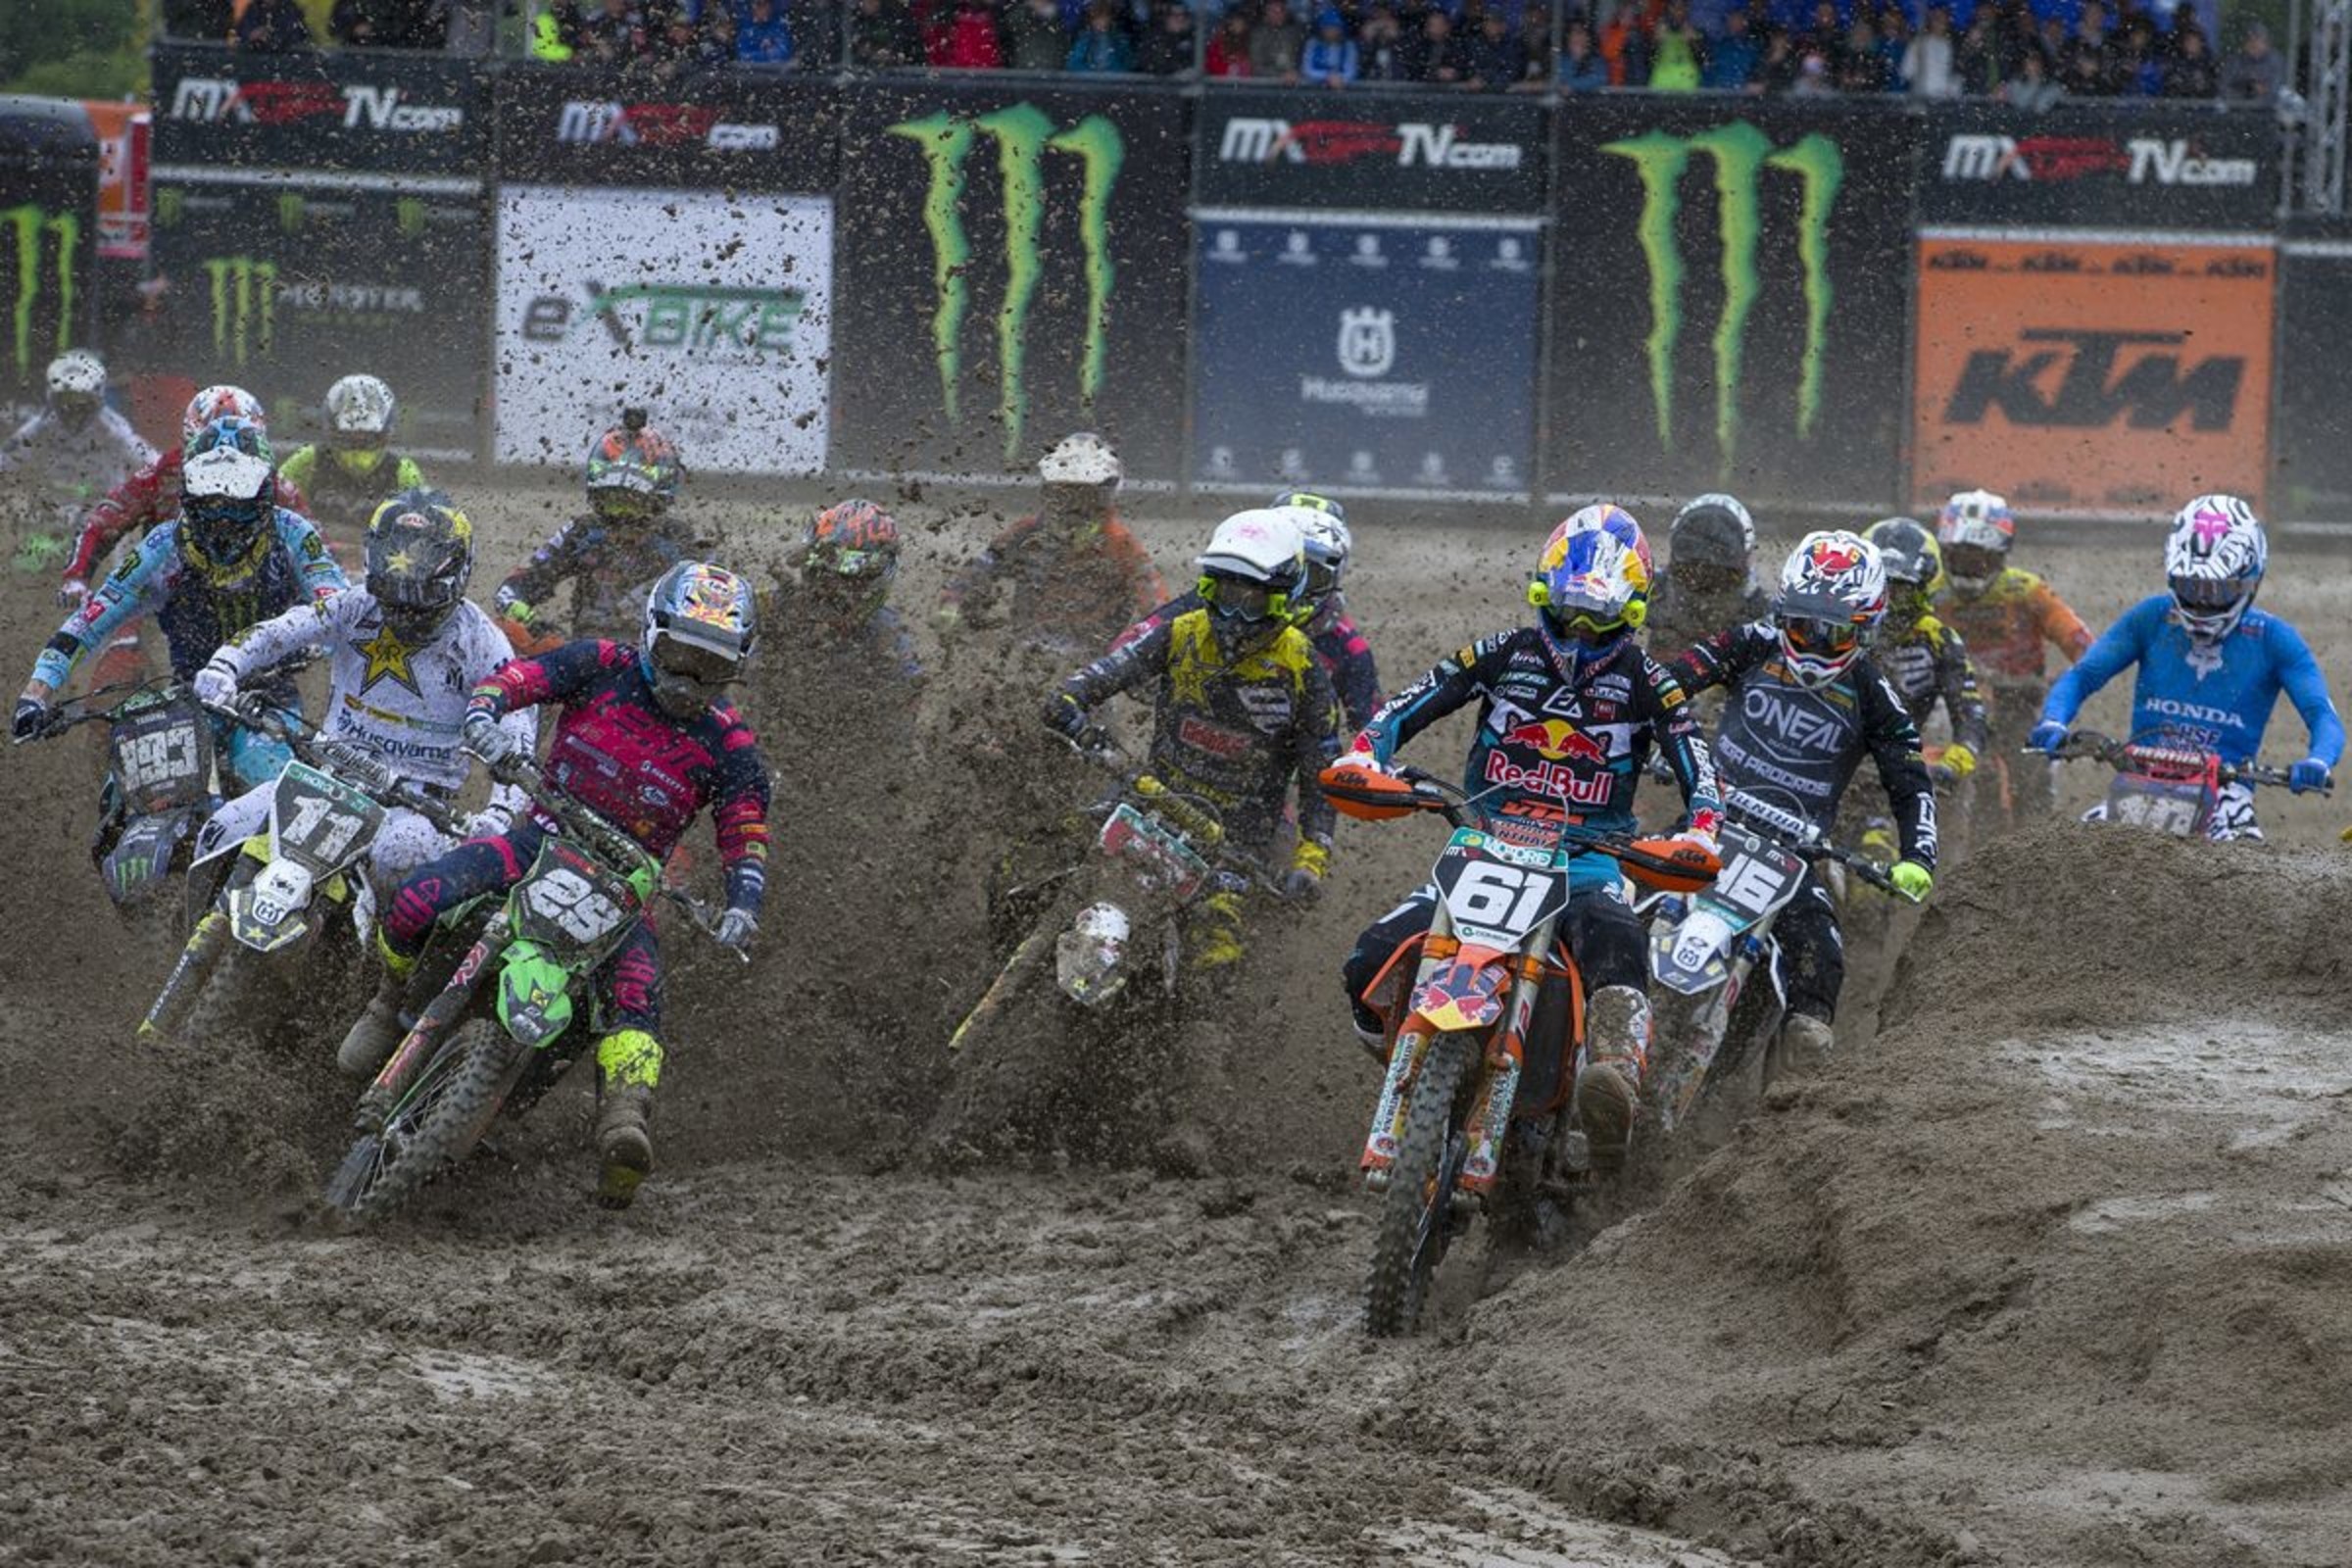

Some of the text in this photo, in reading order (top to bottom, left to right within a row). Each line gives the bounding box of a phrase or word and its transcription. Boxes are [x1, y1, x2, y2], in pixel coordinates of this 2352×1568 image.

[1942, 328, 2246, 433] KTM
[349, 725, 453, 760] Husqvarna
[2145, 698, 2245, 729] HONDA
[119, 725, 199, 792] 193
[1333, 770, 1369, 786] KTM
[1485, 749, 1614, 806] Red Bull
[281, 795, 365, 864] 11
[1447, 859, 1554, 931] 61
